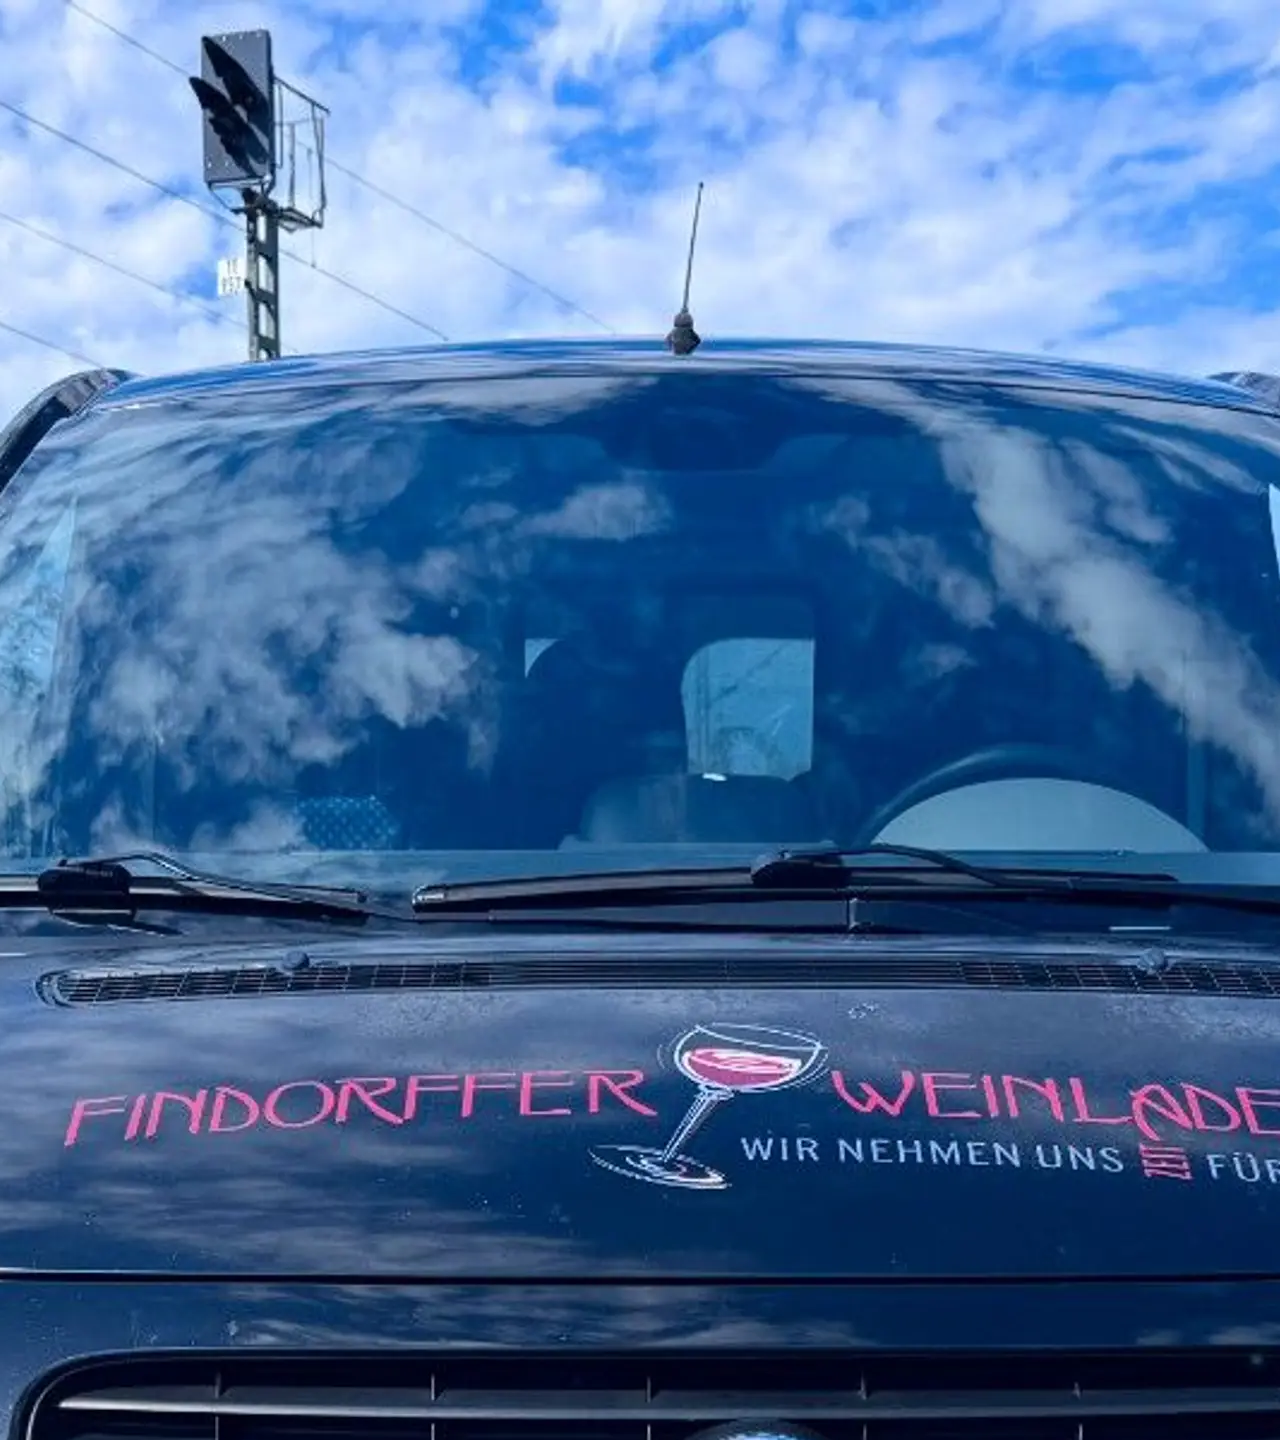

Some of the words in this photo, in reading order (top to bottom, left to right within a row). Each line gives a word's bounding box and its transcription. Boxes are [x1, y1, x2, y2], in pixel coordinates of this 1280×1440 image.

[64, 1068, 659, 1147] FINDORFFER
[740, 1136, 820, 1162] WIR
[837, 1137, 1021, 1169] NEHMEN
[1034, 1144, 1125, 1175] UNS
